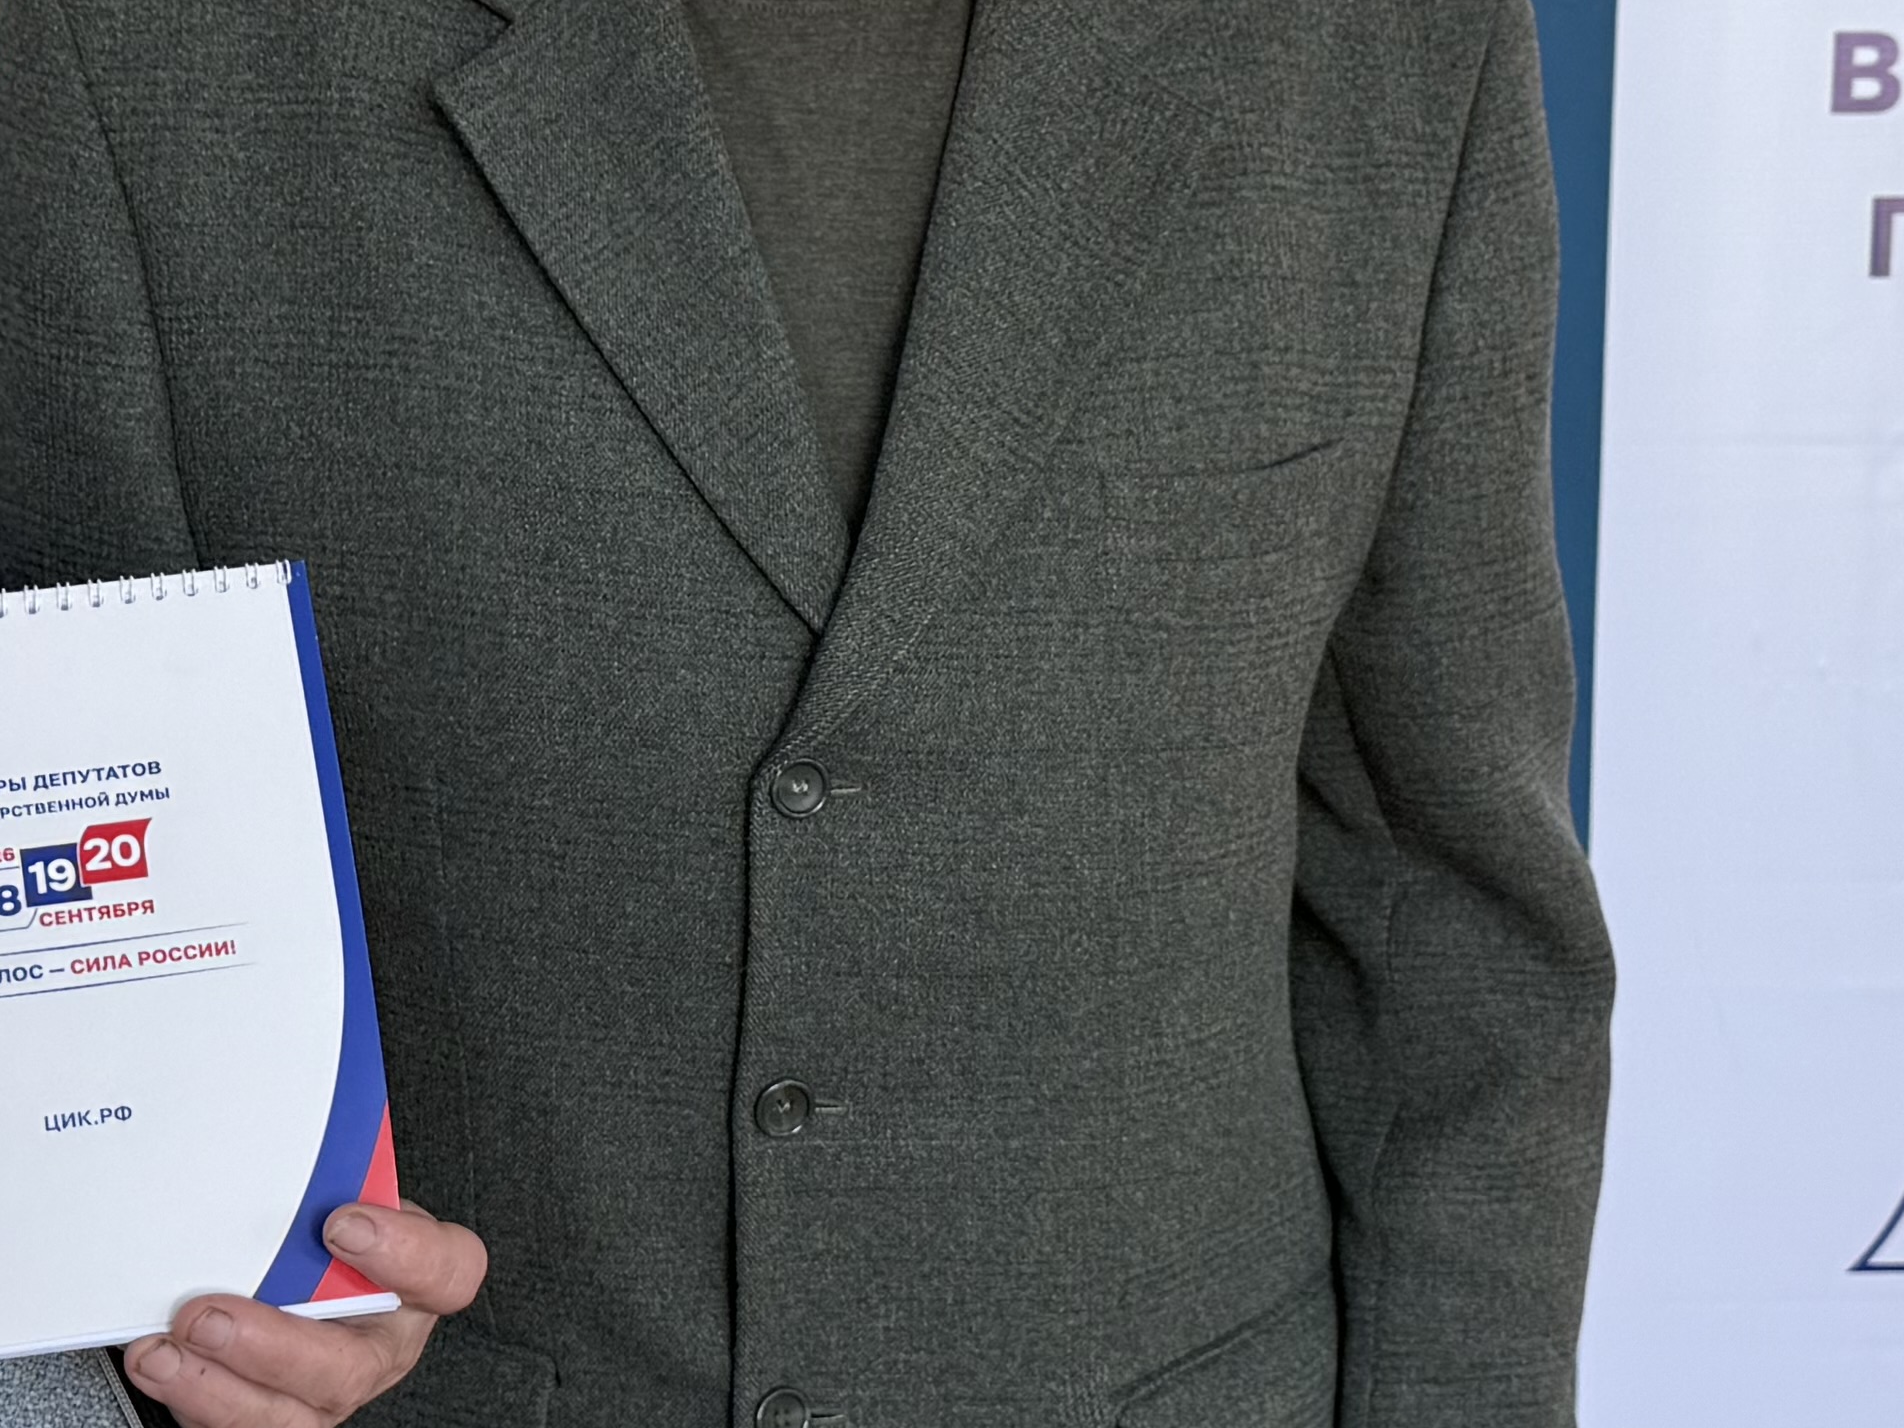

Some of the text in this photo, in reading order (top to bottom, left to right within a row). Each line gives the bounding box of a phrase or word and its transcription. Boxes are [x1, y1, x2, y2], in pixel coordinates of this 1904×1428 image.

[33, 761, 162, 791] ДЕПУТАТОВ
[115, 787, 170, 807] ДУМЫ
[27, 858, 77, 895] 19
[82, 833, 142, 872] 20
[39, 899, 155, 928] СЕНТЯБРЯ
[70, 952, 133, 975] СИЛА
[138, 939, 237, 968] РОССИИ!
[44, 1105, 132, 1133] ЦИК.РФ
